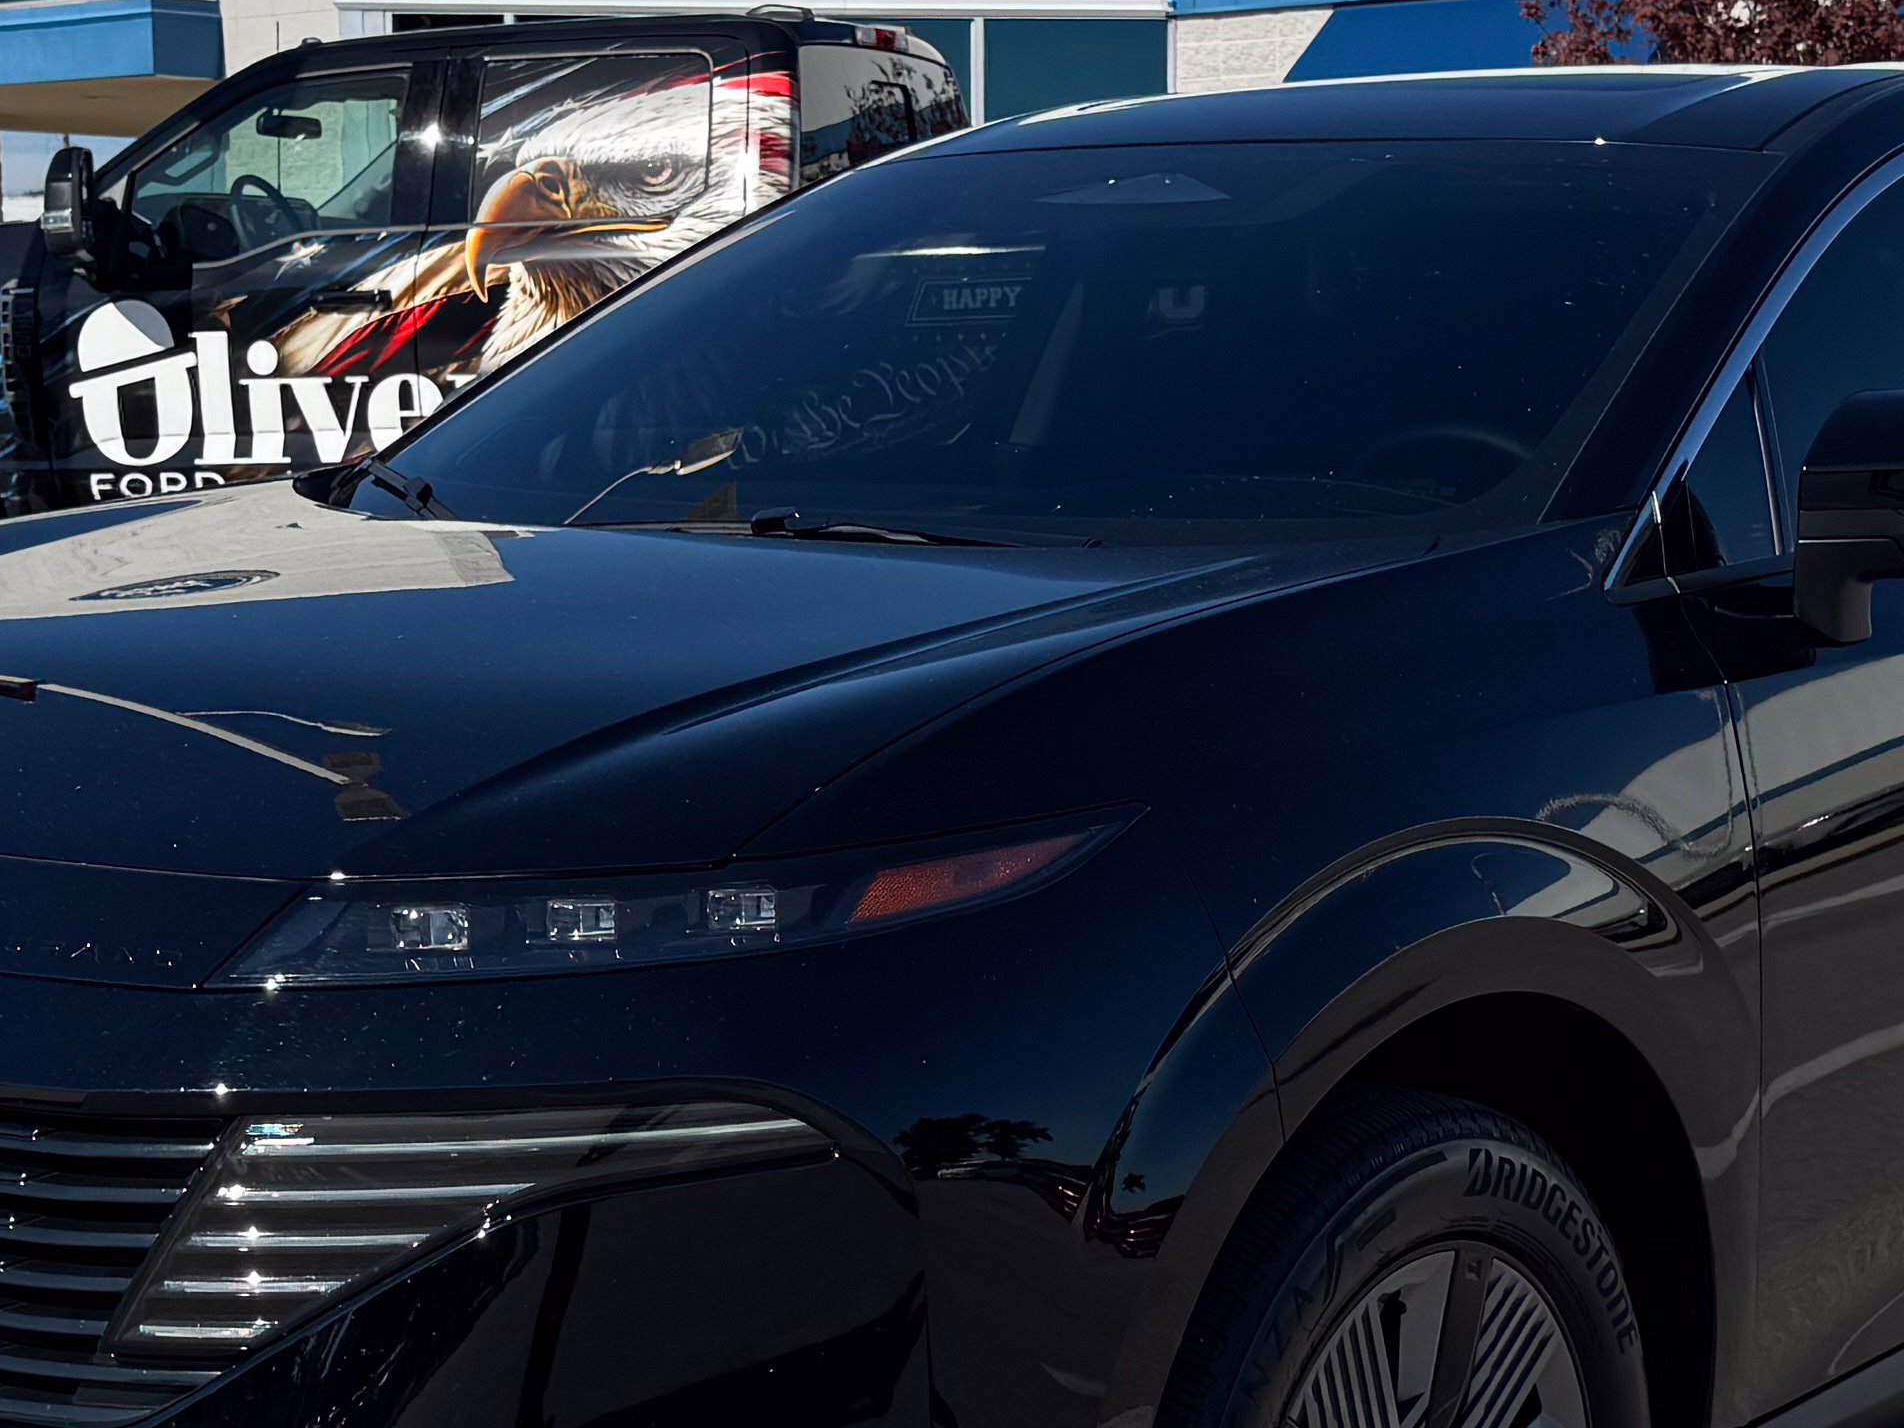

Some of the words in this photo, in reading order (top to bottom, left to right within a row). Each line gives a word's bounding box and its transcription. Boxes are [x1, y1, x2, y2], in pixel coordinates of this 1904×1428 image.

[942, 285, 1024, 312] HAPPY
[68, 299, 481, 466] Olive
[1463, 1147, 1639, 1354] BRIDGESTONE
